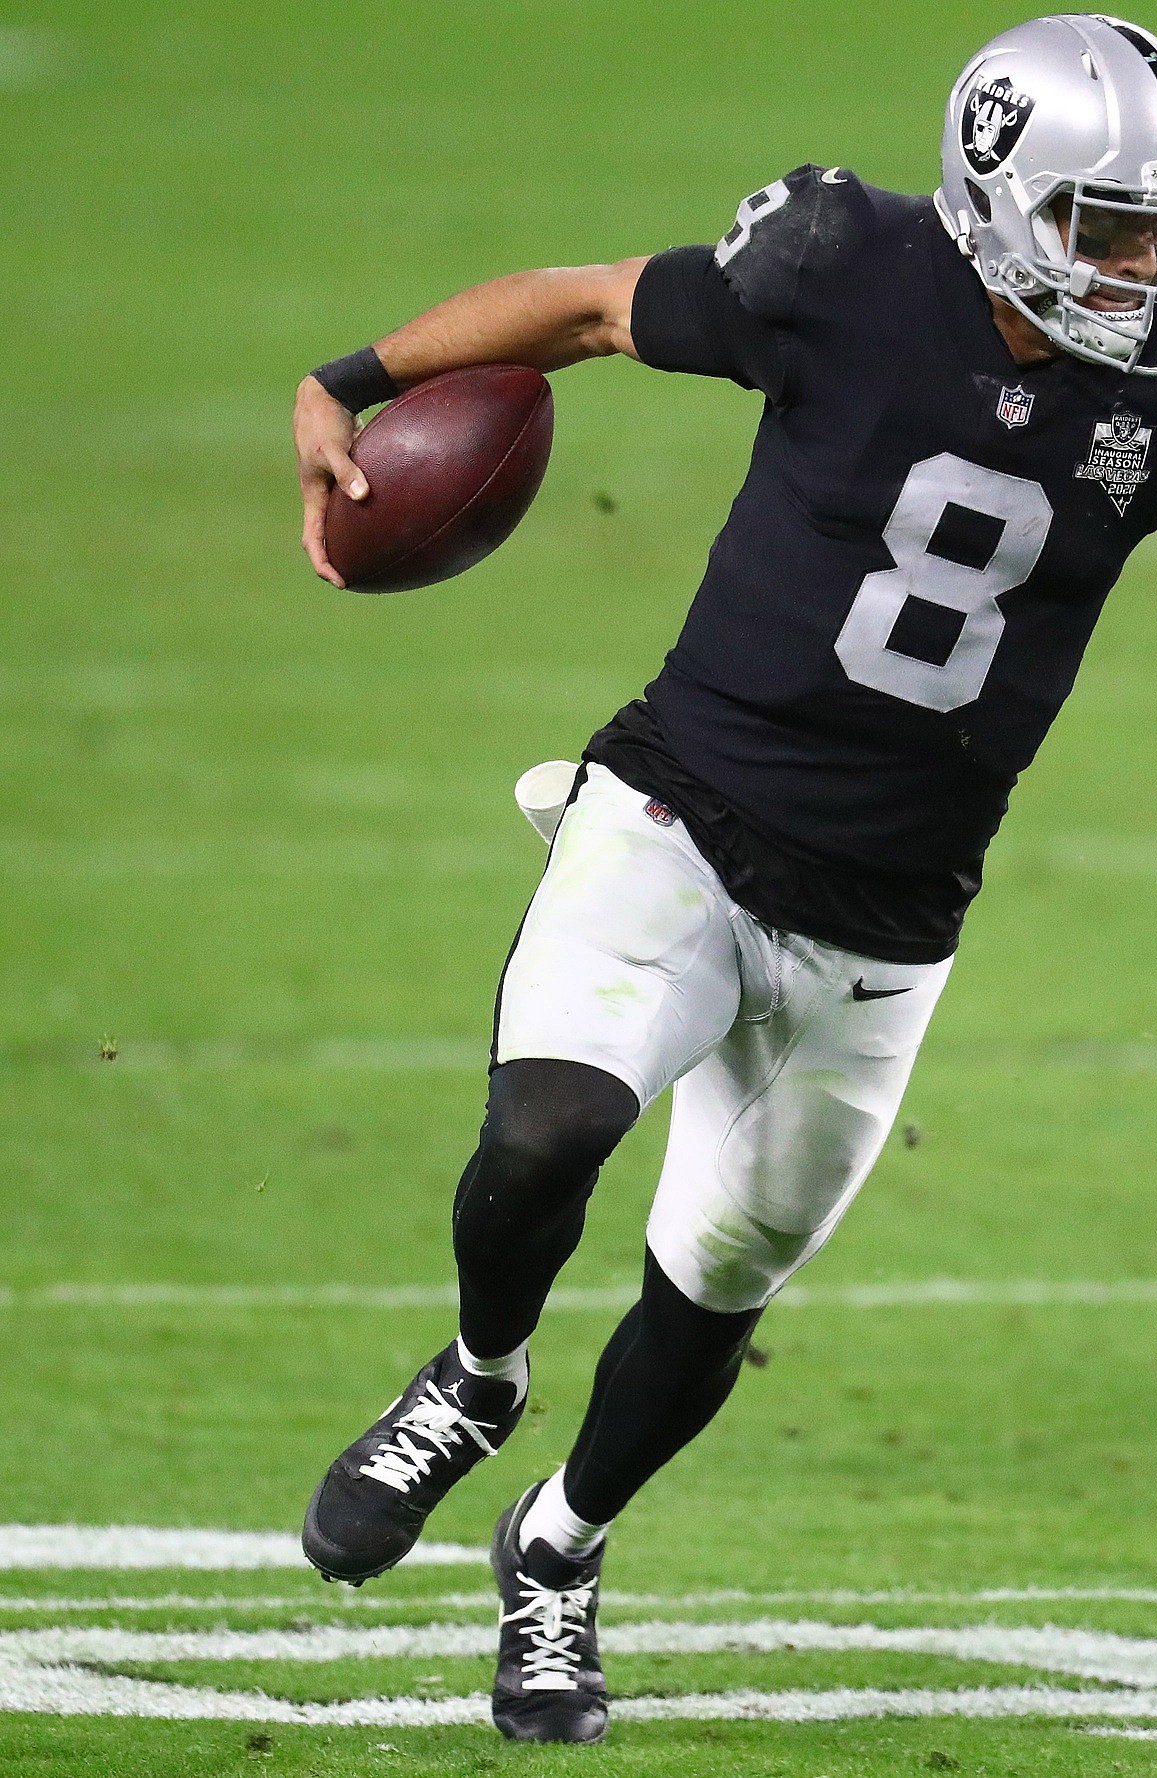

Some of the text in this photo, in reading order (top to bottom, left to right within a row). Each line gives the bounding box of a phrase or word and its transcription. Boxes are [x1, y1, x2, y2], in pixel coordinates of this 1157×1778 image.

[1002, 404, 1024, 421] NFL
[1094, 449, 1141, 460] INAUGURAL
[1092, 456, 1140, 469] SEASON
[1075, 464, 1150, 483] LAS VEGAS
[1108, 484, 1136, 494] 2020
[834, 452, 1053, 713] 8
